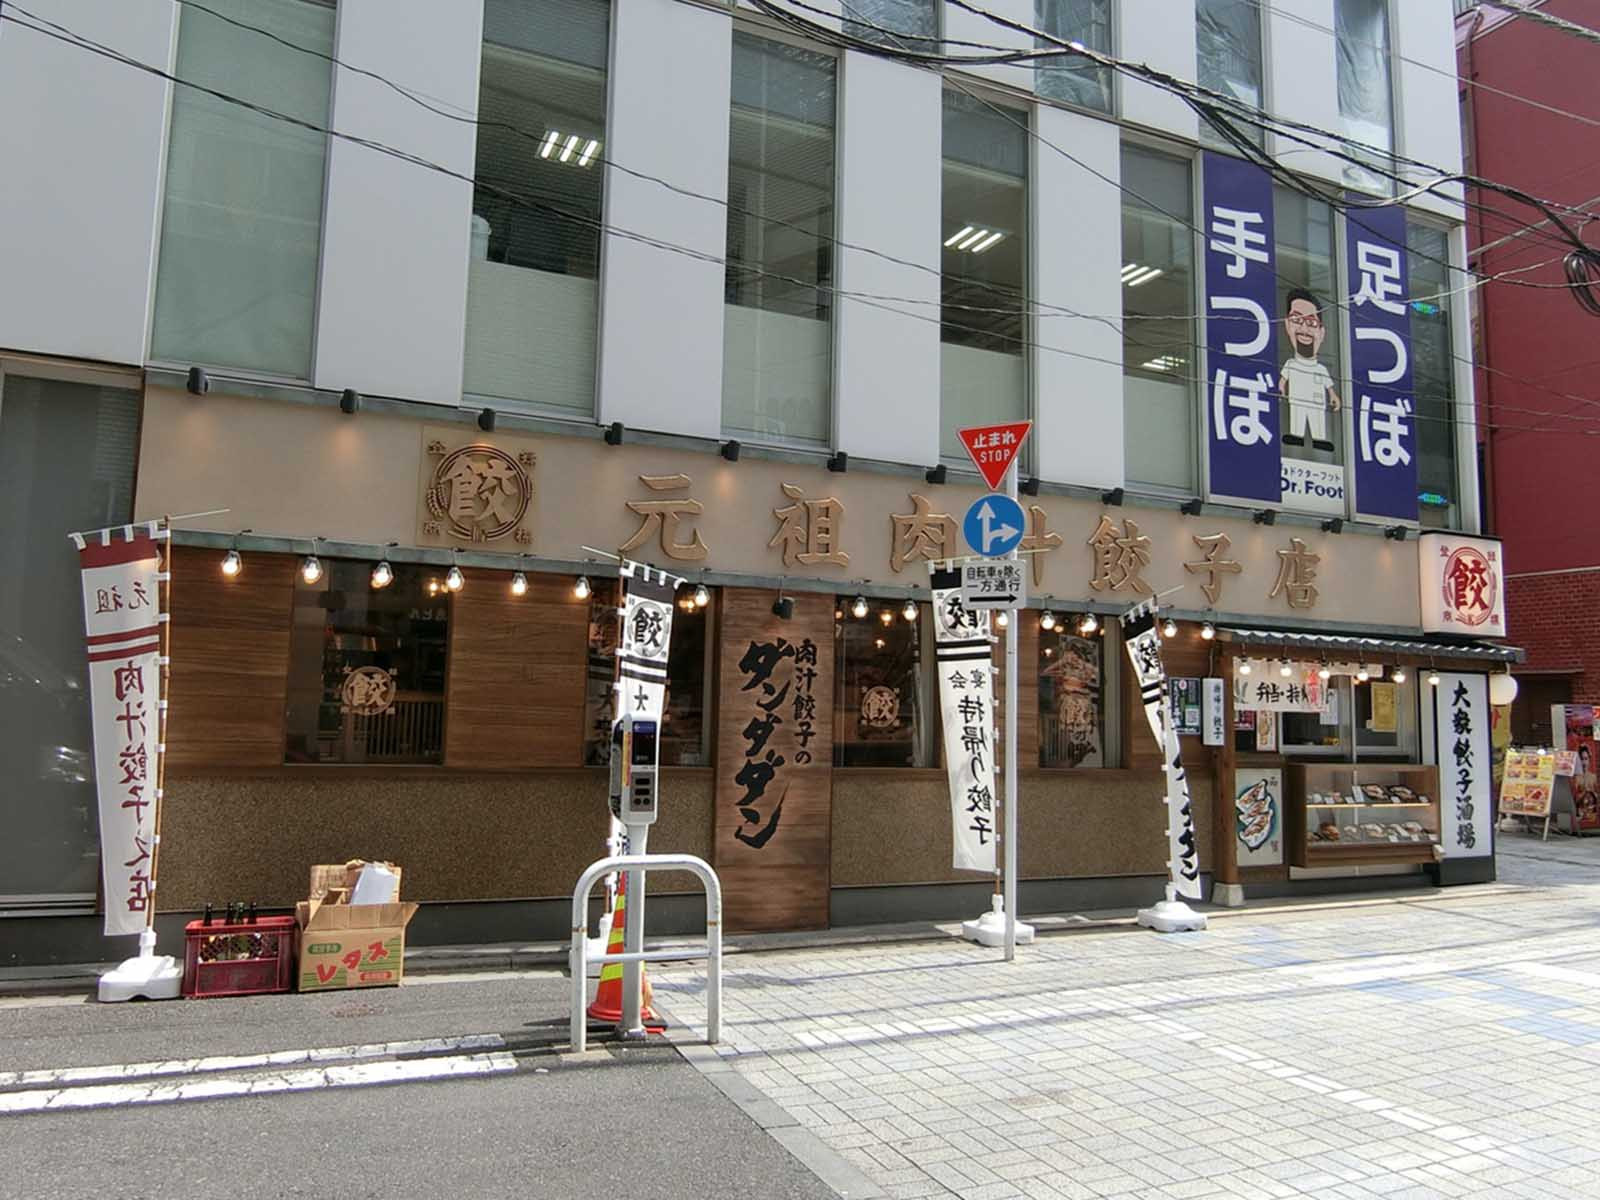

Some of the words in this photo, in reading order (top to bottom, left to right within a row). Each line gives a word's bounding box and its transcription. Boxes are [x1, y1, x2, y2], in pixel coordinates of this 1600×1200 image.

[1210, 206, 1274, 445] 手つぼ
[1355, 240, 1412, 467] 足つぼ
[972, 431, 1016, 449] 止まれ
[979, 449, 1011, 463] STOP
[440, 454, 519, 526] 餃
[1305, 481, 1344, 498] Foot
[966, 579, 1021, 592] 一方通行
[967, 565, 1020, 580] 自転車を除く
[1448, 557, 1489, 610] 餃
[632, 607, 662, 647] 餃
[792, 638, 817, 764] 肉汁餃子の
[734, 637, 796, 849] ダンダダン
[1451, 680, 1476, 849] 大衆餃子酒場
